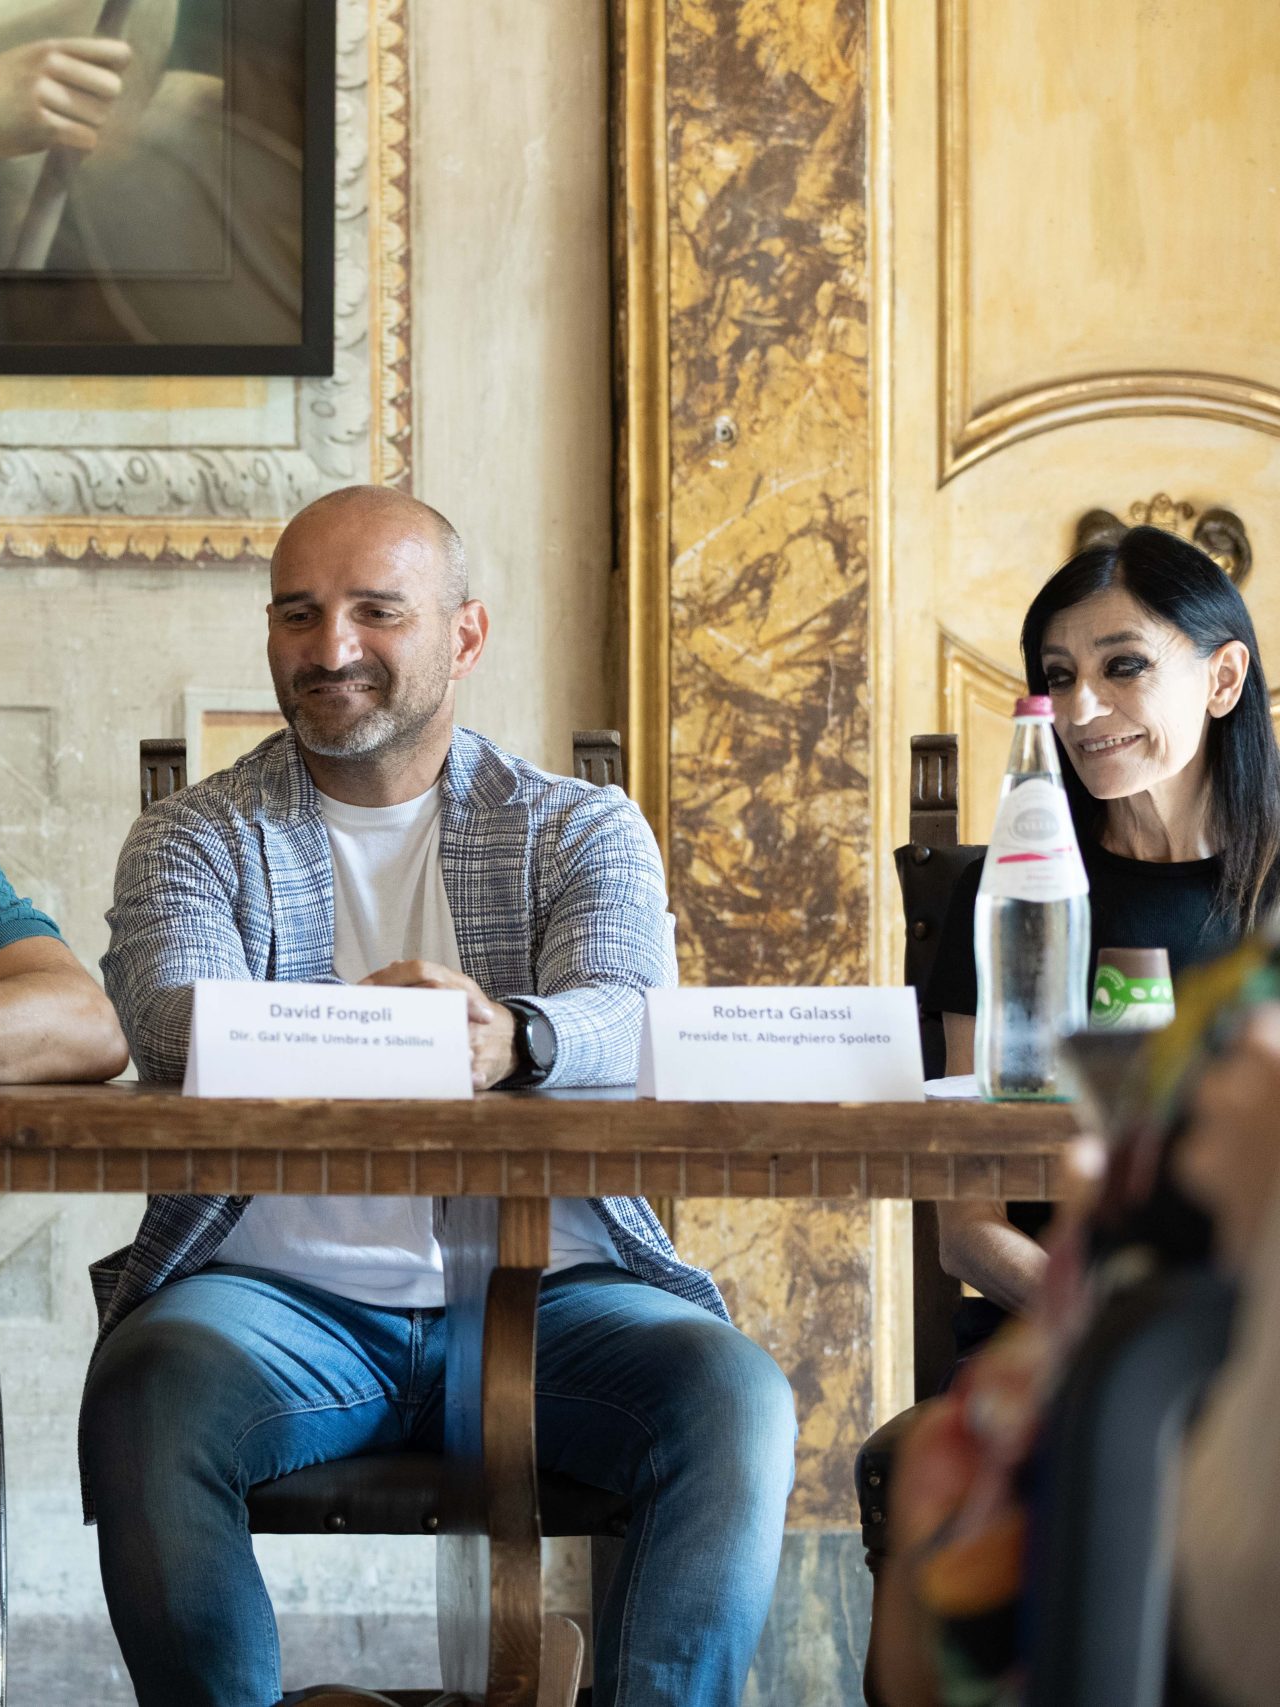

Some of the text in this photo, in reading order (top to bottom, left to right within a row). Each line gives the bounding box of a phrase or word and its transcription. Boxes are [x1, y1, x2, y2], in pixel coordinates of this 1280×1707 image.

[269, 1004, 392, 1023] David Fongoli
[713, 1006, 852, 1021] Roberta Galassi
[229, 1030, 254, 1042] Dir.
[258, 1031, 280, 1043] Gal
[283, 1032, 318, 1044] Valle
[322, 1033, 368, 1046] Umbra
[372, 1037, 380, 1046] e
[678, 1031, 891, 1046] Preside Ist. Alberghiero Spoleto
